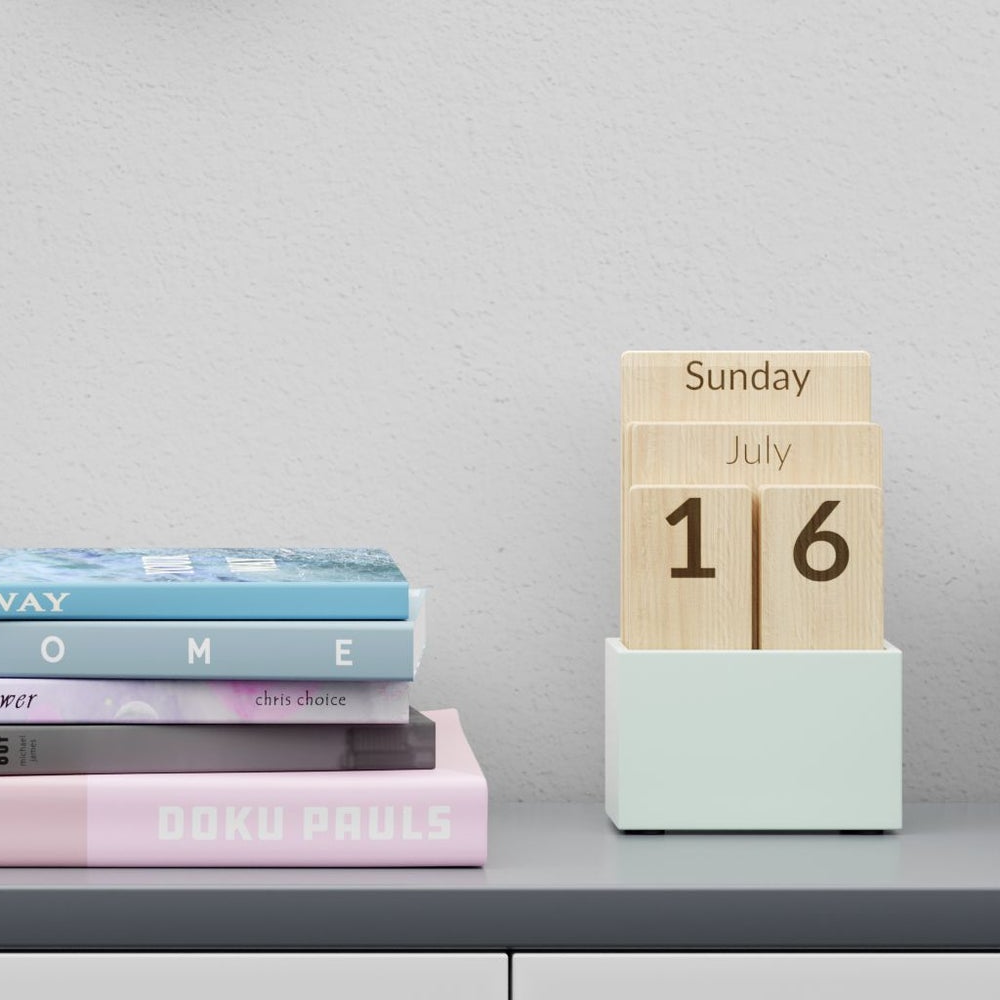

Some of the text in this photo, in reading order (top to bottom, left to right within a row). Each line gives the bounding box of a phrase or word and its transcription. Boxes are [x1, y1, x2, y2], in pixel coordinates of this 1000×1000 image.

[685, 359, 811, 397] Sunday
[726, 435, 792, 471] July
[255, 690, 347, 706] chris choice
[19, 735, 27, 767] michael
[29, 738, 37, 763] james
[157, 805, 453, 843] DOKU PAULS
